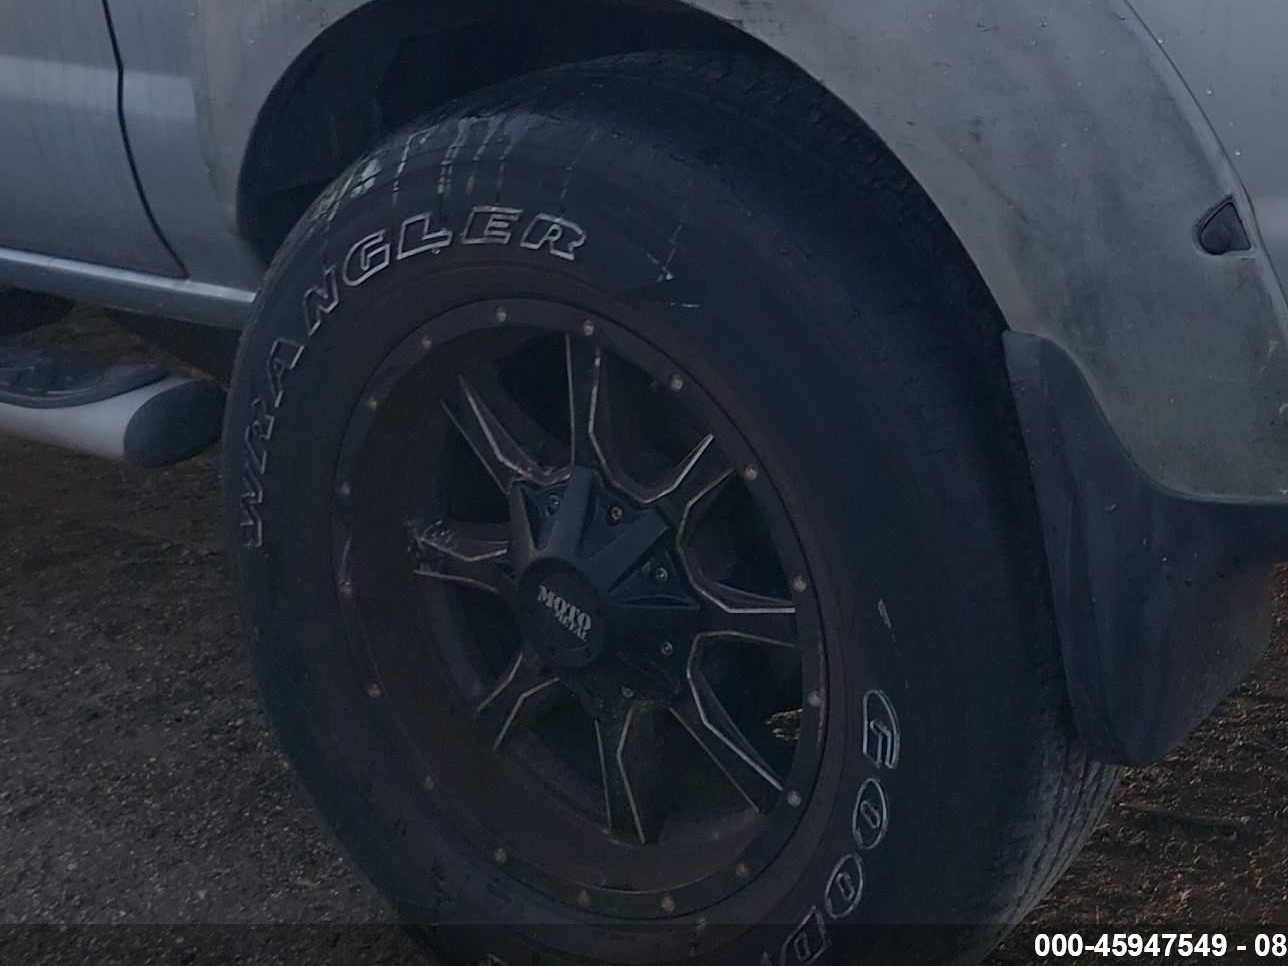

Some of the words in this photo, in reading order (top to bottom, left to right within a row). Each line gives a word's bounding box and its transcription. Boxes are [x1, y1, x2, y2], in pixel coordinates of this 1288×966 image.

[240, 205, 586, 548] WRANGLER
[537, 585, 592, 630] MOTO
[761, 690, 900, 965] GOOD
